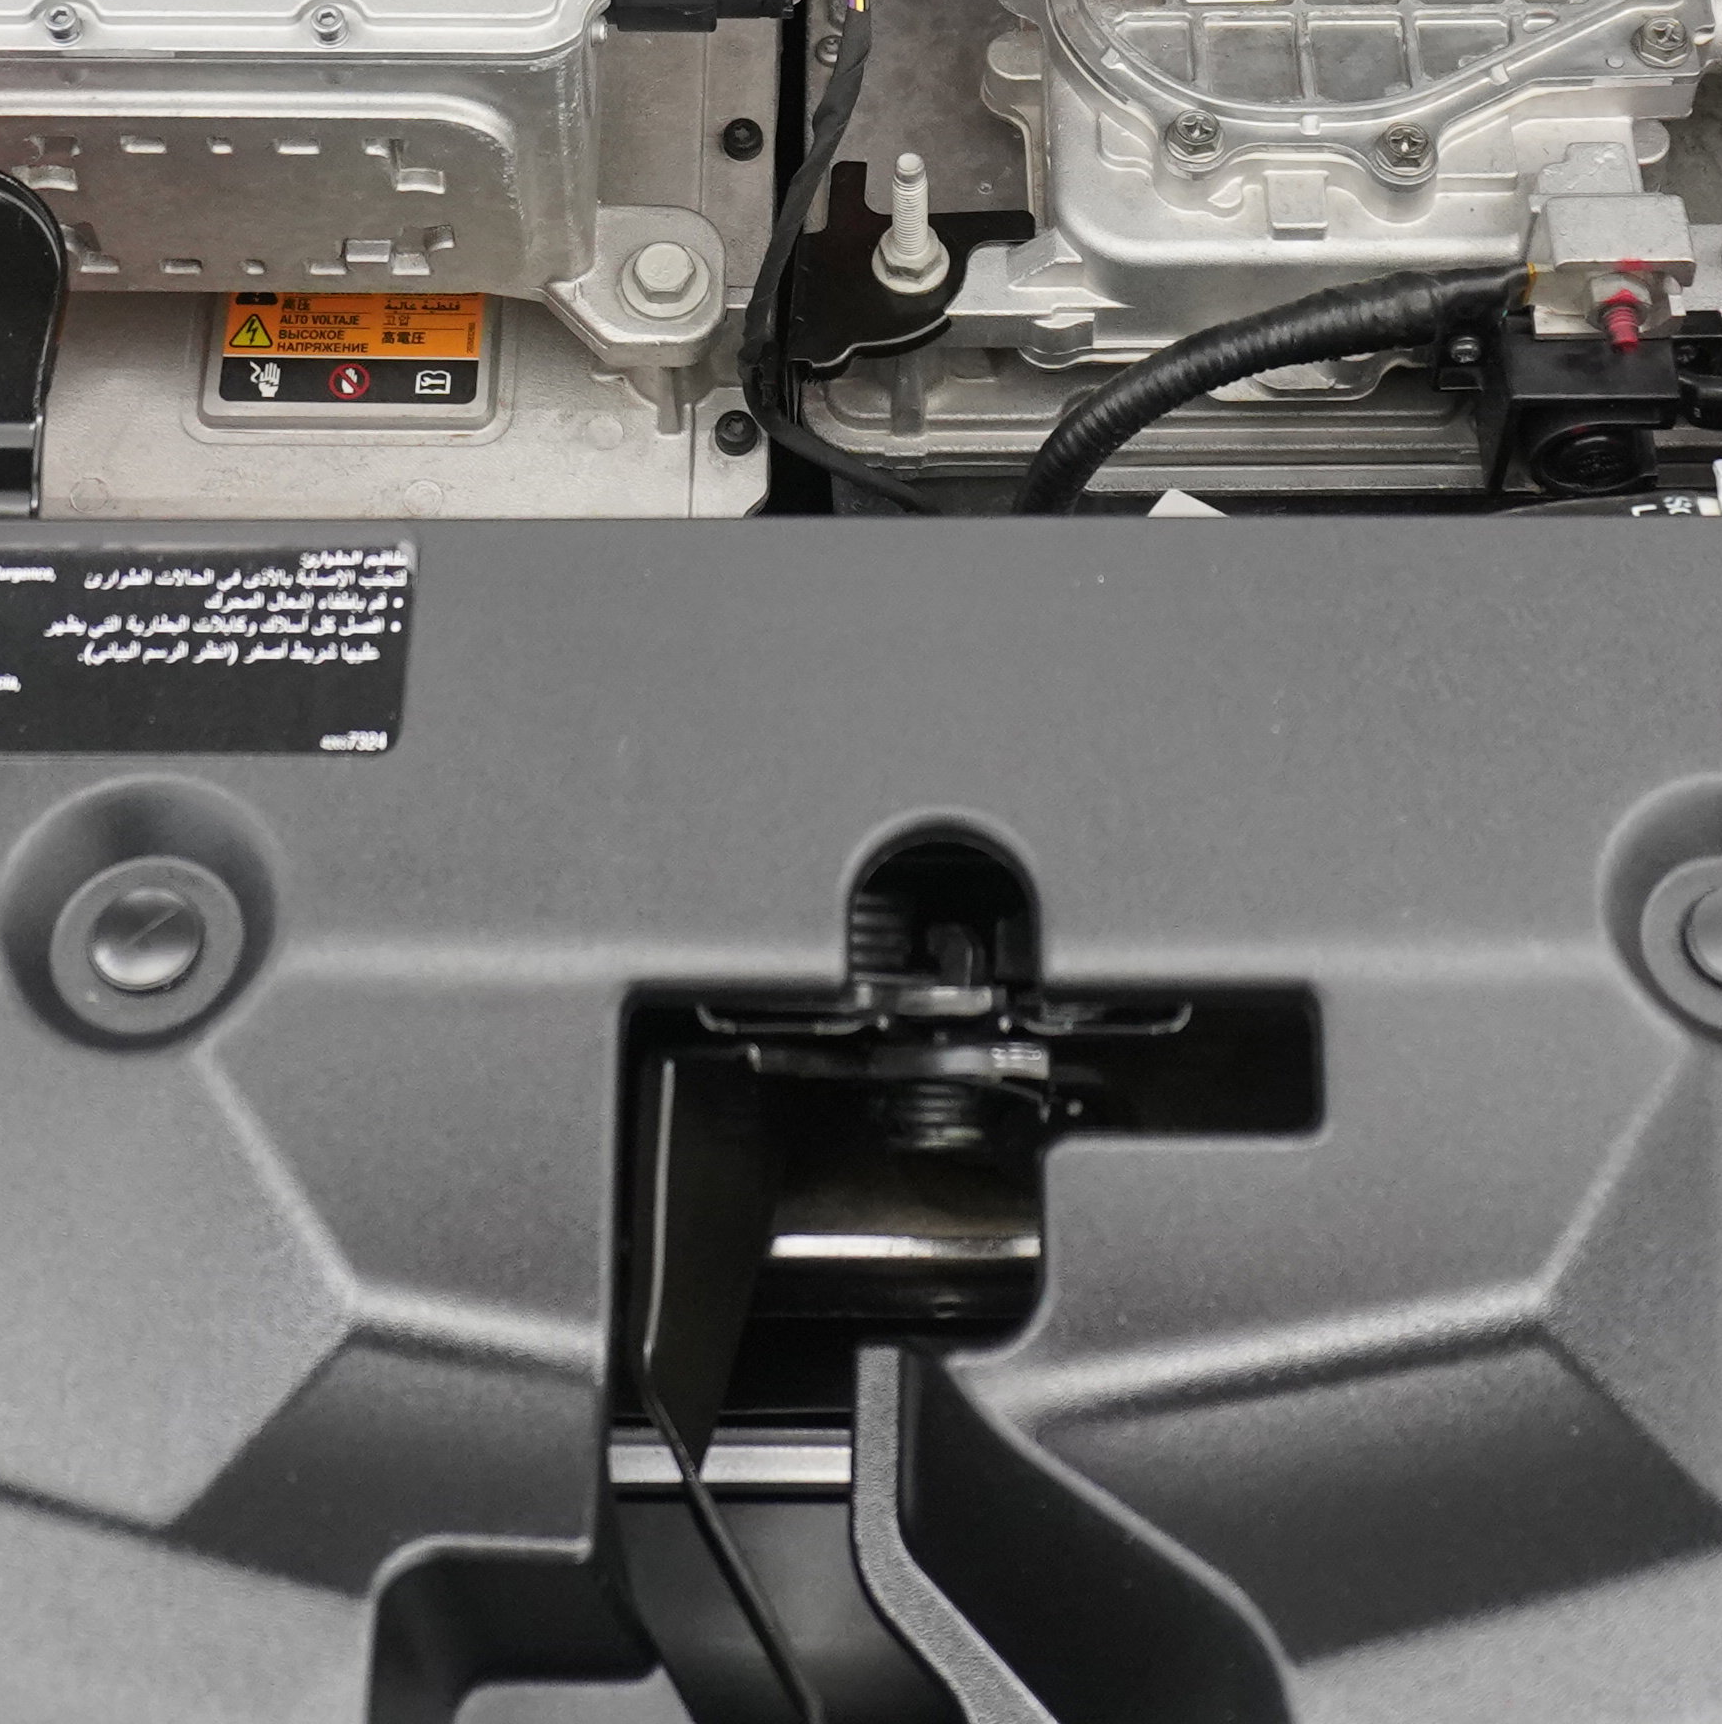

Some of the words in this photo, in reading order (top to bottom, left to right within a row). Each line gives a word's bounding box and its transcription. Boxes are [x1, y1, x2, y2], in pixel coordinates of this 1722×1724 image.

[280, 314, 309, 325] ALTO
[312, 315, 361, 326] VOLTAJE
[382, 314, 411, 327] 고압
[278, 329, 346, 341] ВЫСОКОЕ
[381, 331, 426, 345] 高電圧
[277, 342, 369, 354] НАПРЯЖЕНИЕ
